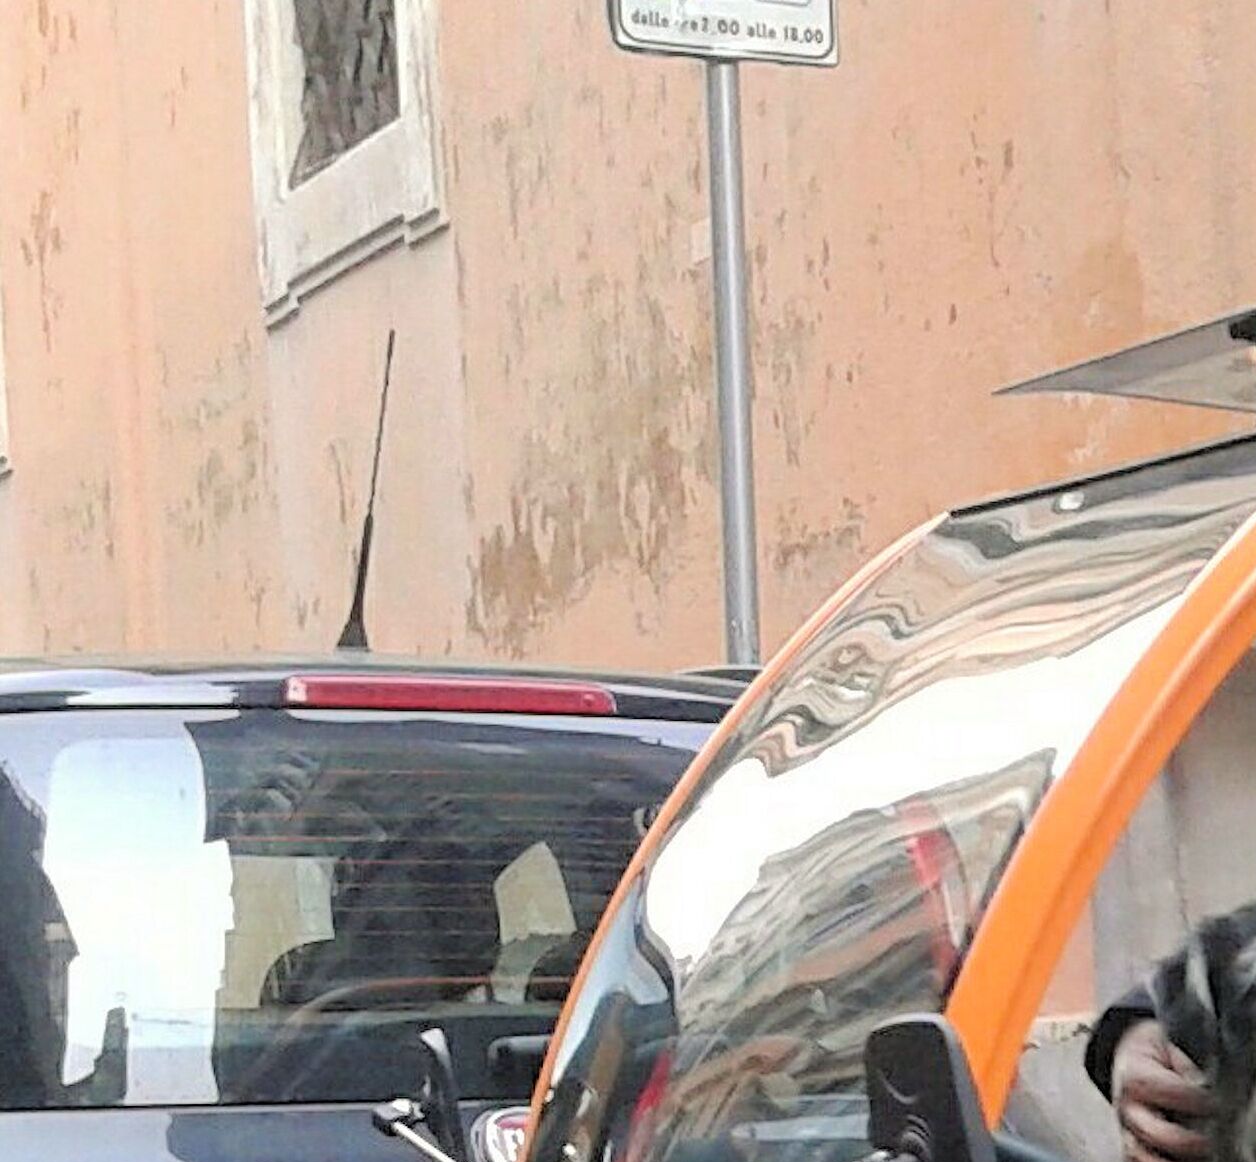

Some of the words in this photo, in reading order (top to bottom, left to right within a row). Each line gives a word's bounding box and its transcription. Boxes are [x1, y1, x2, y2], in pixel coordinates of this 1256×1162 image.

[631, 10, 669, 28] dalle
[746, 23, 777, 40] alle
[783, 26, 824, 44] 18.00
